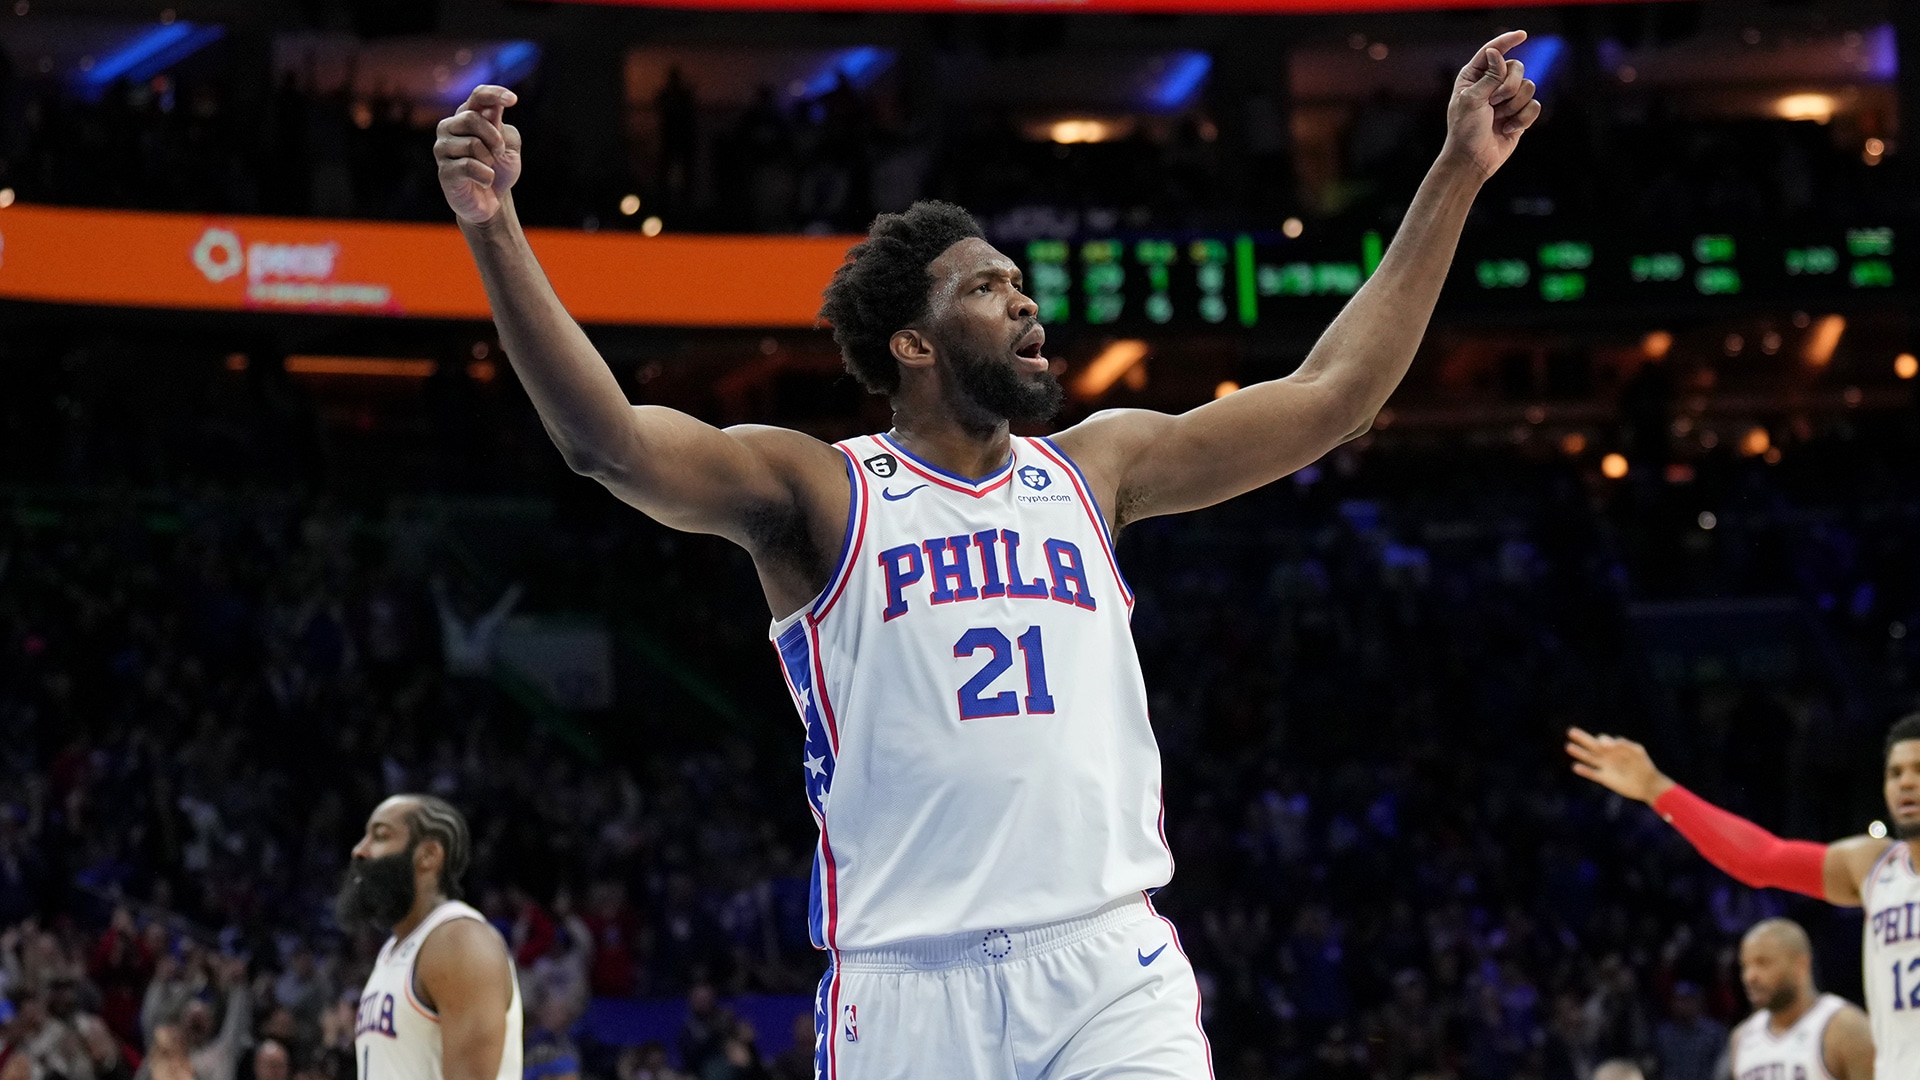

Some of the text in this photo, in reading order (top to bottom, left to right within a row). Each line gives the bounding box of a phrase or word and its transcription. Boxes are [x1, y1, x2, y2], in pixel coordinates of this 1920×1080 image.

[870, 456, 891, 477] 6
[1017, 493, 1071, 504] crypto.com
[878, 528, 1097, 623] PHILA
[953, 625, 1056, 721] 21
[1873, 902, 1920, 946] PHI
